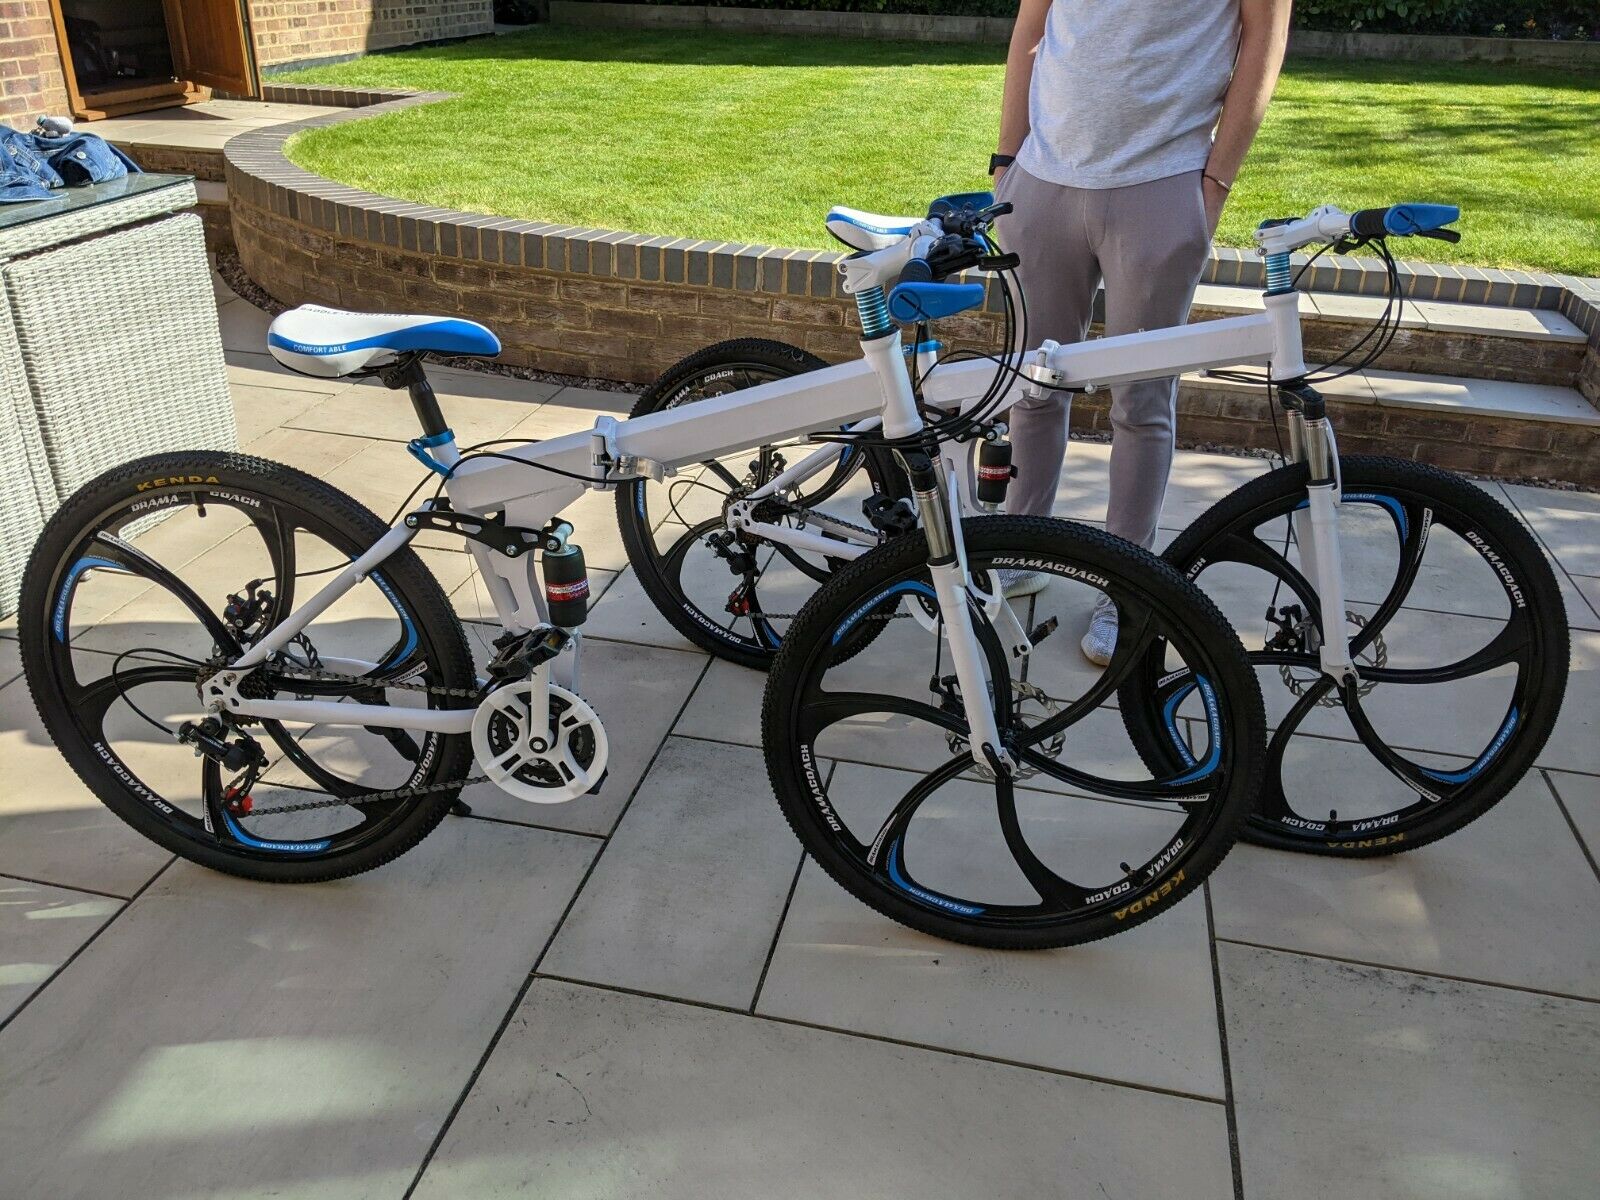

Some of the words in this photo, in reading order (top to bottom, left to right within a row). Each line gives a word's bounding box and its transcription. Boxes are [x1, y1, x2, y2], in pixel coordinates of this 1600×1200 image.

[704, 370, 734, 383] COACH
[131, 494, 179, 512] DRAMA
[209, 491, 260, 508] COACH
[136, 476, 221, 491] KENDA
[991, 557, 1110, 588] DRAMACOACH
[1465, 531, 1526, 609] DRAMACOACH
[683, 603, 742, 644] DRAMACOACH
[837, 589, 890, 637] DRAMACOACH
[1203, 683, 1220, 750] DRAMACOACH
[1478, 716, 1517, 771] DRAMACOACH
[93, 742, 174, 814] DRAMACOACH
[800, 744, 842, 832] DRAMACOACH
[1281, 815, 1326, 831] COACH
[1327, 832, 1404, 849] KENDA
[1351, 814, 1399, 832] DRAMA
[1146, 838, 1184, 877] DRAMA
[1084, 881, 1131, 905] COACH
[1114, 869, 1186, 920] KENDA
